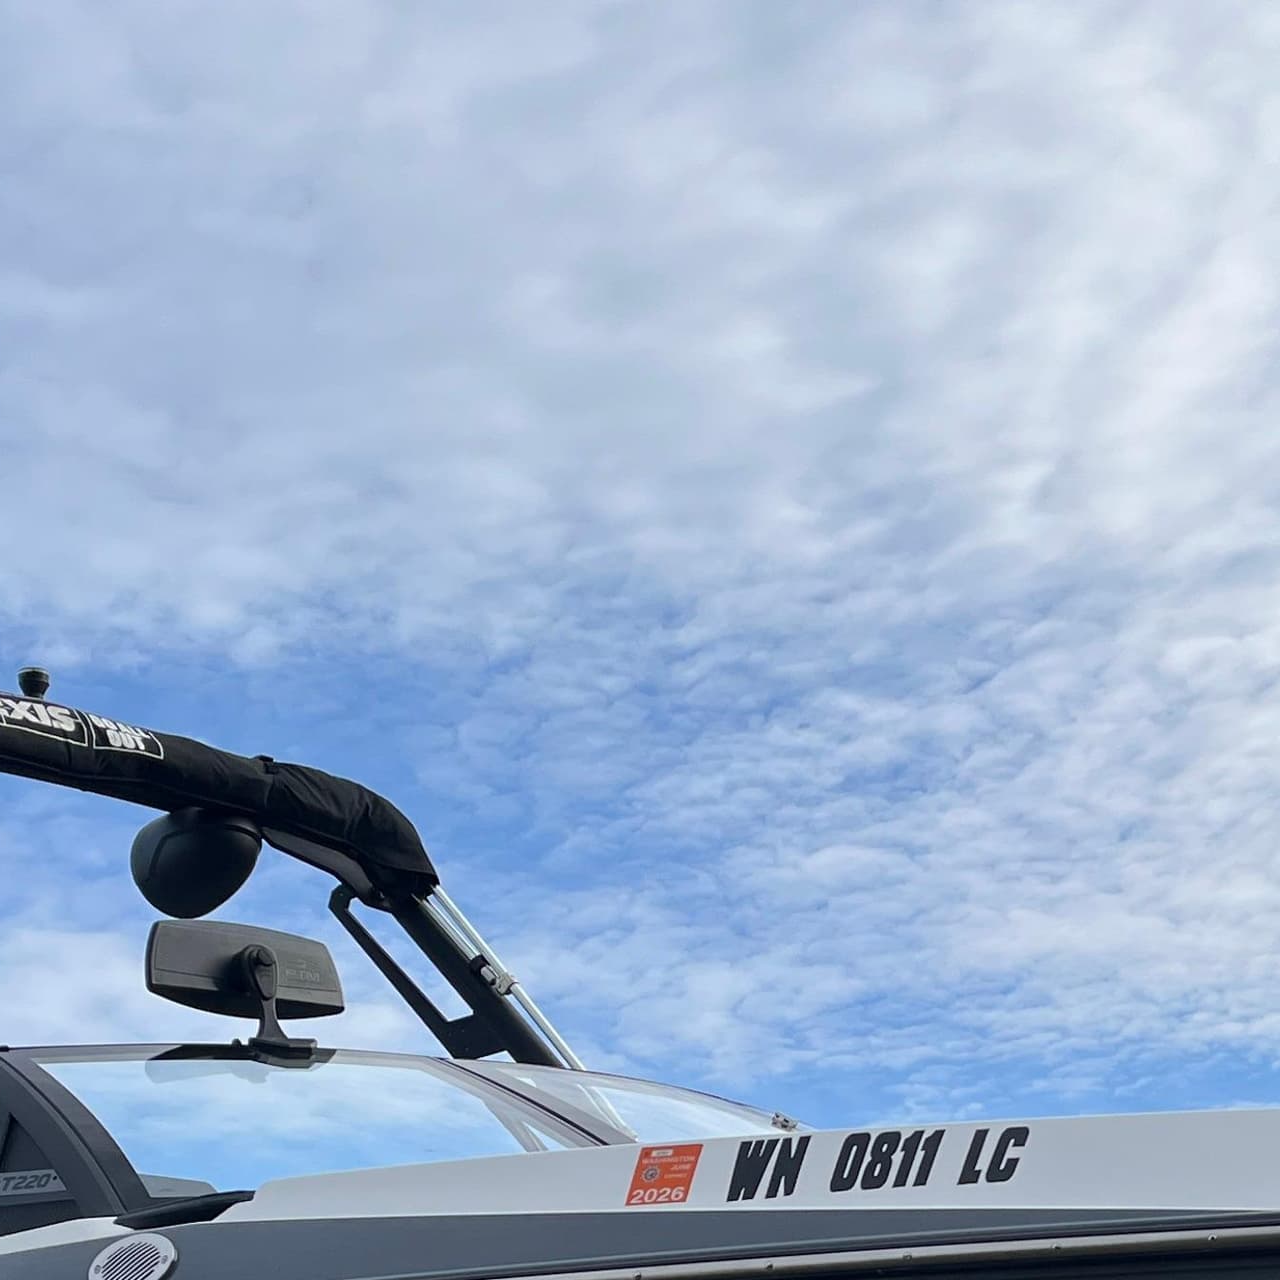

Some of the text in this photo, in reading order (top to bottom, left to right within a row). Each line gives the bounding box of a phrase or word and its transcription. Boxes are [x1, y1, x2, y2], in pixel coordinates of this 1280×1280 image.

[106, 729, 145, 750] OUT
[726, 1126, 1030, 1202] WN 0811 LC
[2, 1173, 51, 1191] T220
[629, 1186, 685, 1204] 2026
